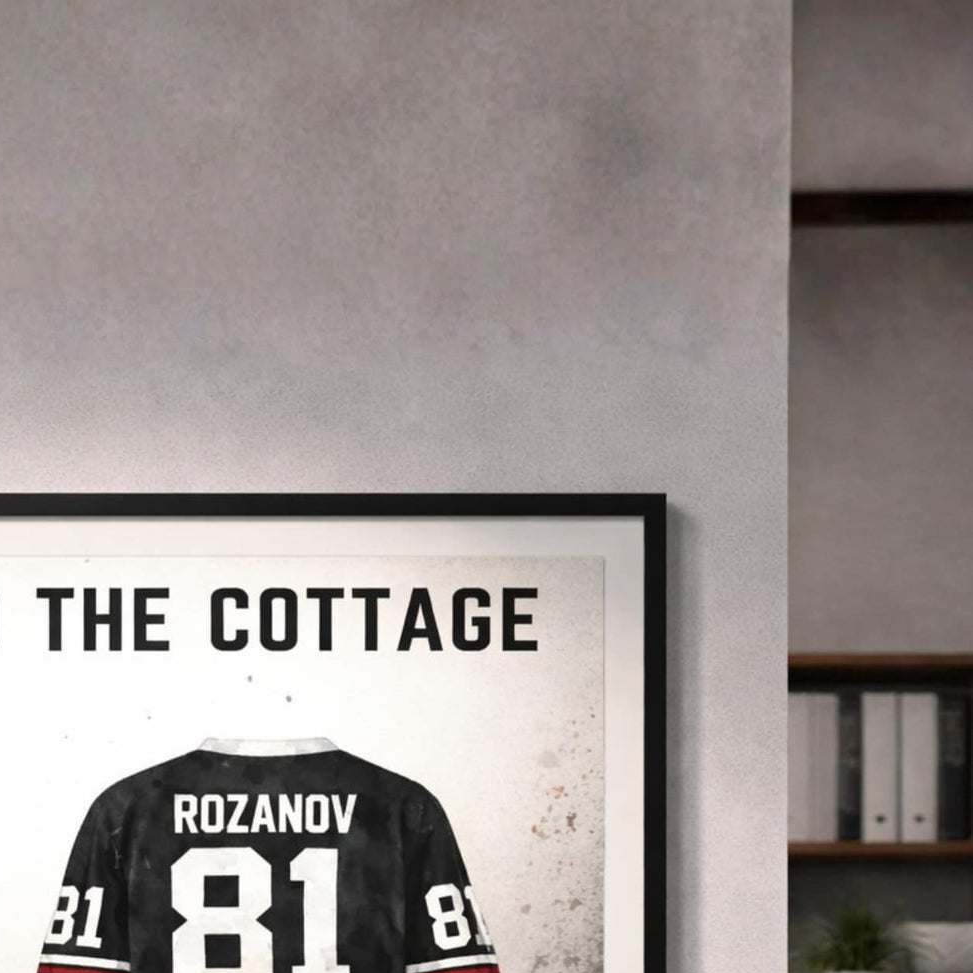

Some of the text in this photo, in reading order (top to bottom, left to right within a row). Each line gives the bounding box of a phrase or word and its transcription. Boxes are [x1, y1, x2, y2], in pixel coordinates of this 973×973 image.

[36, 587, 170, 651] THE
[210, 587, 538, 651] COTTAGE
[173, 793, 357, 834] ROZANOV
